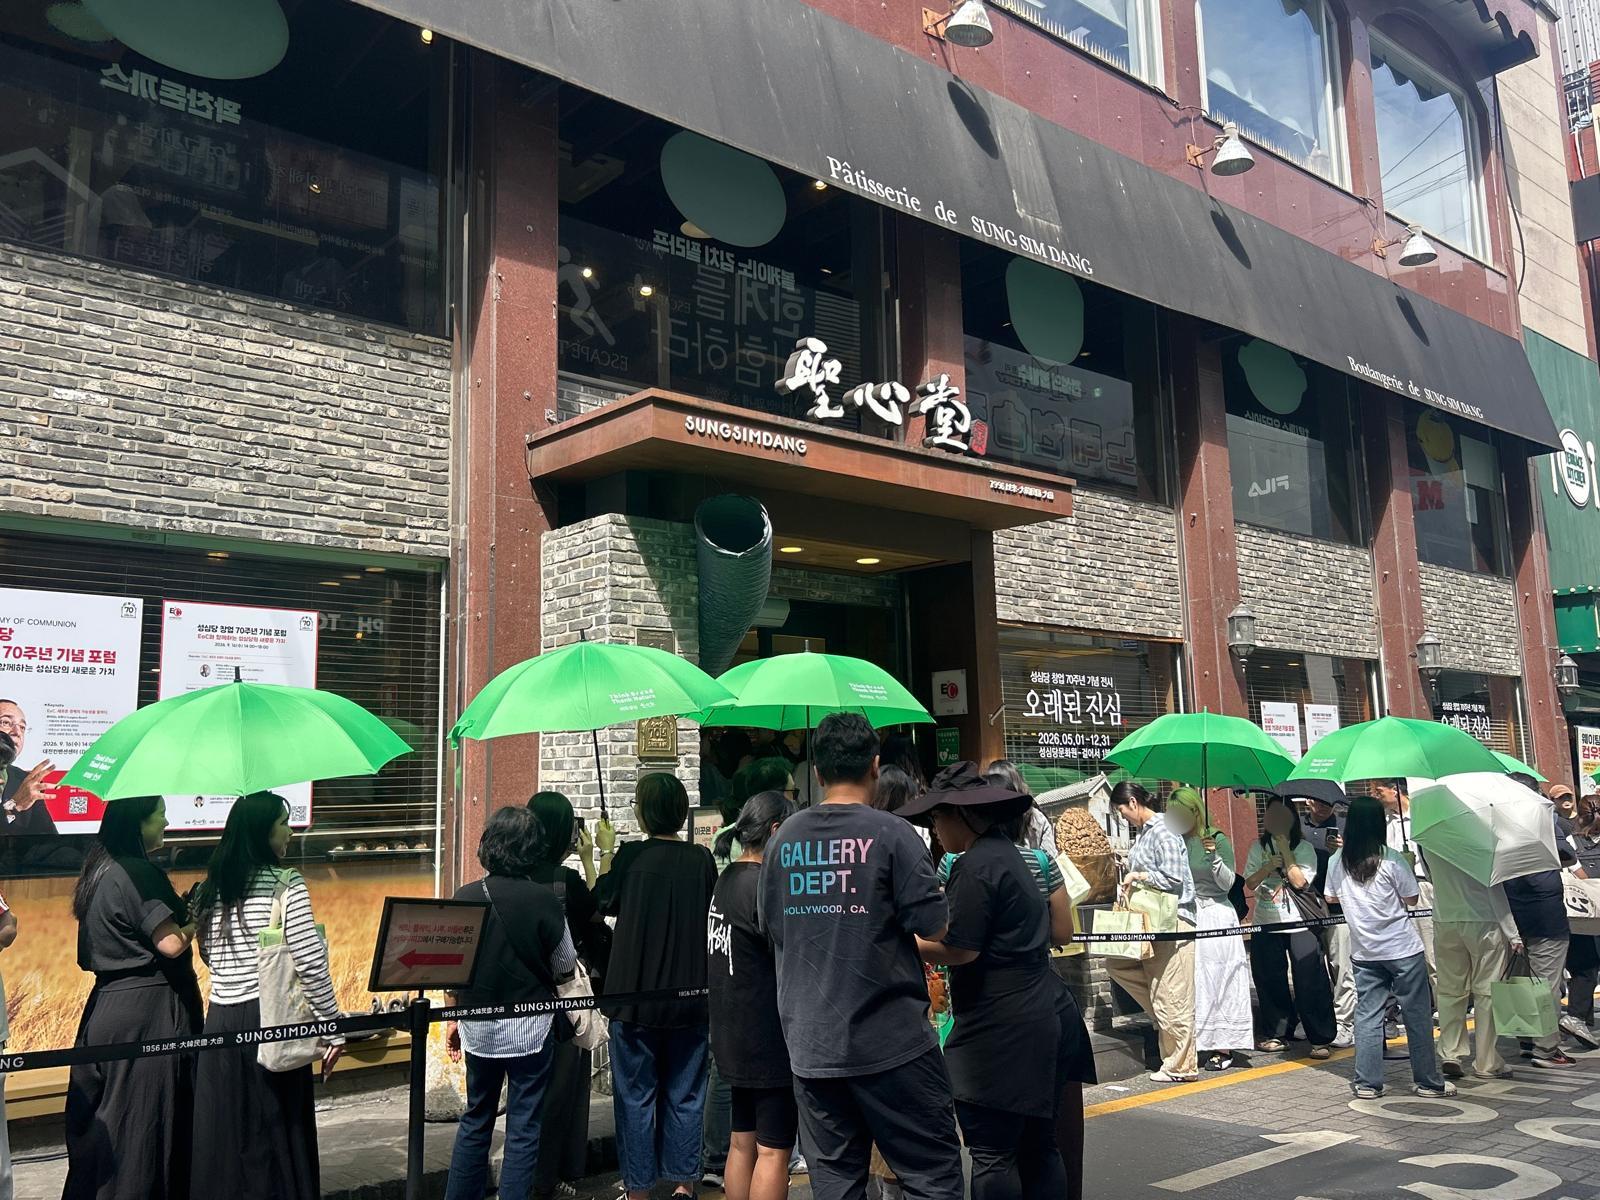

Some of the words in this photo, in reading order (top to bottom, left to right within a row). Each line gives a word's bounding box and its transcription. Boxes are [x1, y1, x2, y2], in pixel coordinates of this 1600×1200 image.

[827, 156, 921, 212] Pâtisserie
[935, 201, 957, 225] de
[972, 216, 1017, 247] SUNG
[1020, 235, 1047, 257] SIM
[1048, 246, 1093, 275] DANG
[777, 337, 971, 452] 聖心堂
[1347, 356, 1404, 391] Boulangerie
[1408, 380, 1421, 397] de
[1425, 389, 1447, 406] SUNG
[1447, 397, 1462, 412] SIM
[1461, 401, 1483, 419] DANG
[685, 415, 808, 455] SUNGSIMDANG
[13, 617, 25, 625] OF
[27, 618, 77, 628] COMMUNION
[197, 624, 218, 633] 성심당
[220, 626, 234, 634] 창업
[235, 627, 258, 635] 70주년
[2, 645, 53, 661] 70주년
[57, 648, 85, 662] 기념
[88, 650, 117, 664] 포럼
[36, 664, 69, 675] 성심당의
[71, 666, 97, 676] 새로운
[99, 667, 115, 677] 가치
[1030, 671, 1051, 684] 성심당
[1052, 673, 1064, 685] 창업
[1065, 674, 1086, 686] 70주년
[1087, 676, 1100, 687] 기념
[1101, 677, 1113, 688] 전시
[1023, 689, 1082, 724] 오래된
[1085, 691, 1122, 726] 진심
[1471, 715, 1491, 740] 진심
[1038, 732, 1110, 747] 2026.05.01-12.31
[1582, 746, 1600, 759] 컵우
[780, 838, 874, 868] GALLERY
[789, 870, 857, 896] DEPT.
[783, 904, 846, 916] HOLLYWOOD,
[850, 904, 869, 914] CA.
[442, 1010, 455, 1018] 1956
[513, 998, 596, 1013] SUNGSIMDANG
[142, 1044, 160, 1053] 1956
[235, 1022, 338, 1044] SUNGSIMDANG
